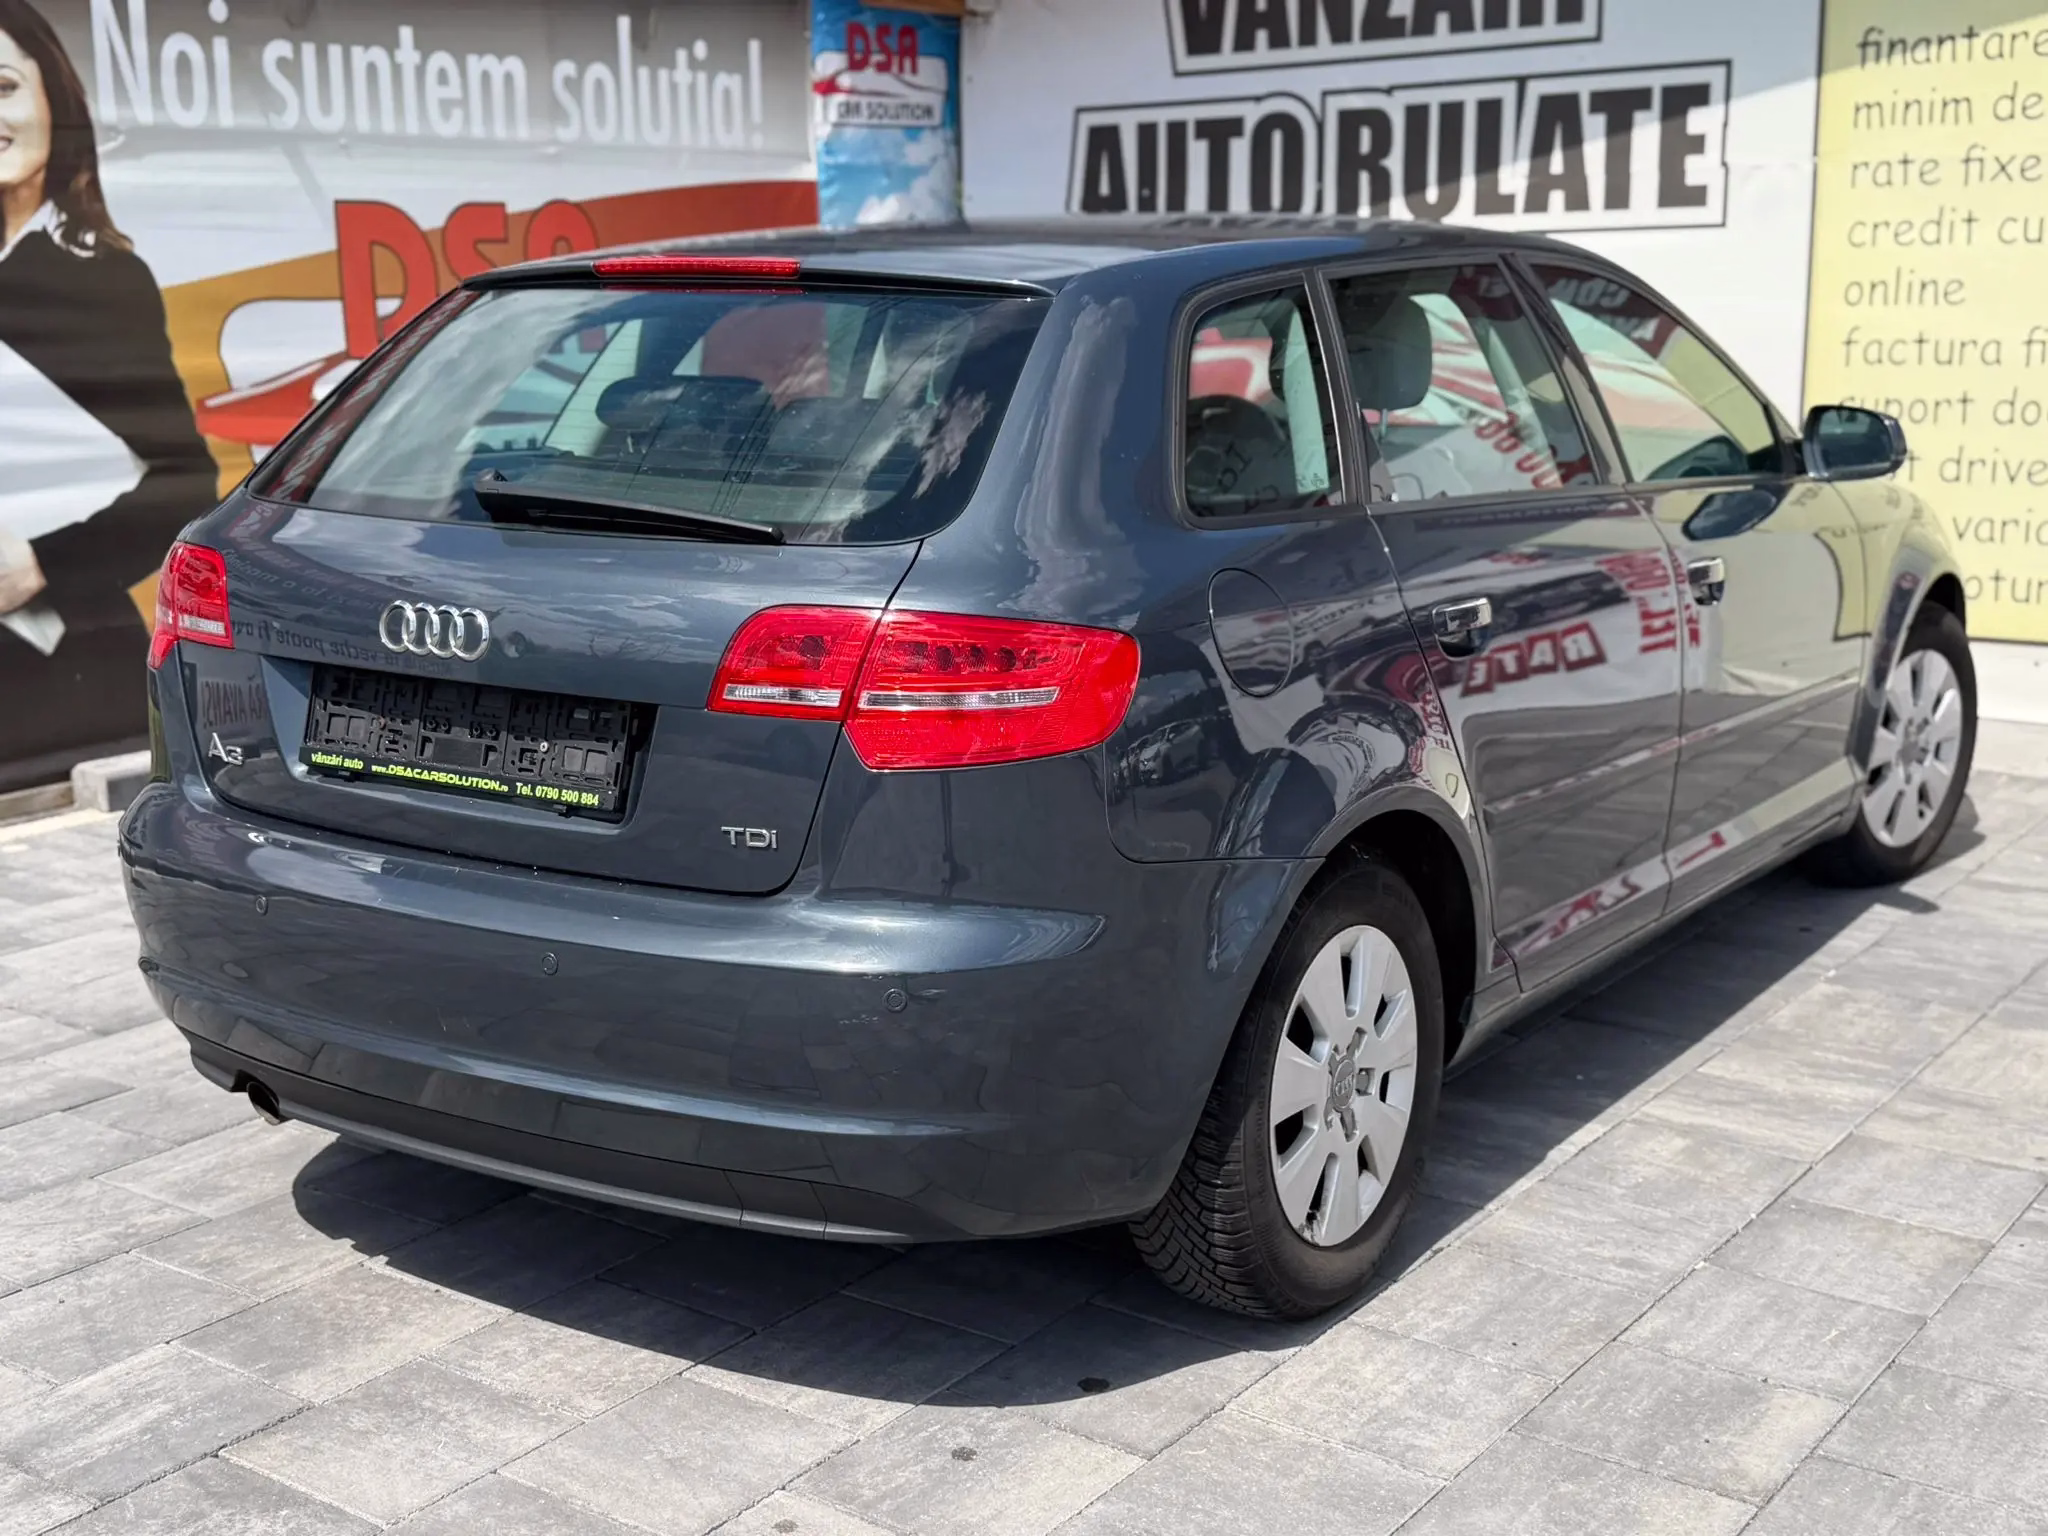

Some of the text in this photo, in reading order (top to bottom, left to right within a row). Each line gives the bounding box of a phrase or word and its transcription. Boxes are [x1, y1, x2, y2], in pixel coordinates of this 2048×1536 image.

[846, 20, 919, 76] DSA
[1857, 25, 2048, 69] finantare
[91, 0, 763, 149] Noi suntem solutia!
[866, 102, 934, 120] SOLUTION
[1853, 81, 2046, 130] minim de
[1080, 82, 1711, 219] AUTO RULATE
[1851, 143, 2045, 189] rate fixe
[1847, 205, 2046, 249] credit cu
[1844, 266, 1966, 308] online
[1841, 327, 2002, 368] factura
[1992, 385, 2048, 427] do
[208, 732, 243, 765] A3
[343, 758, 364, 770] auto
[371, 764, 509, 792] www.DSACARSOLUTION.ro
[515, 782, 534, 796] Tel.
[535, 785, 559, 800] 0790
[560, 789, 579, 803] 500
[580, 793, 600, 806] 884
